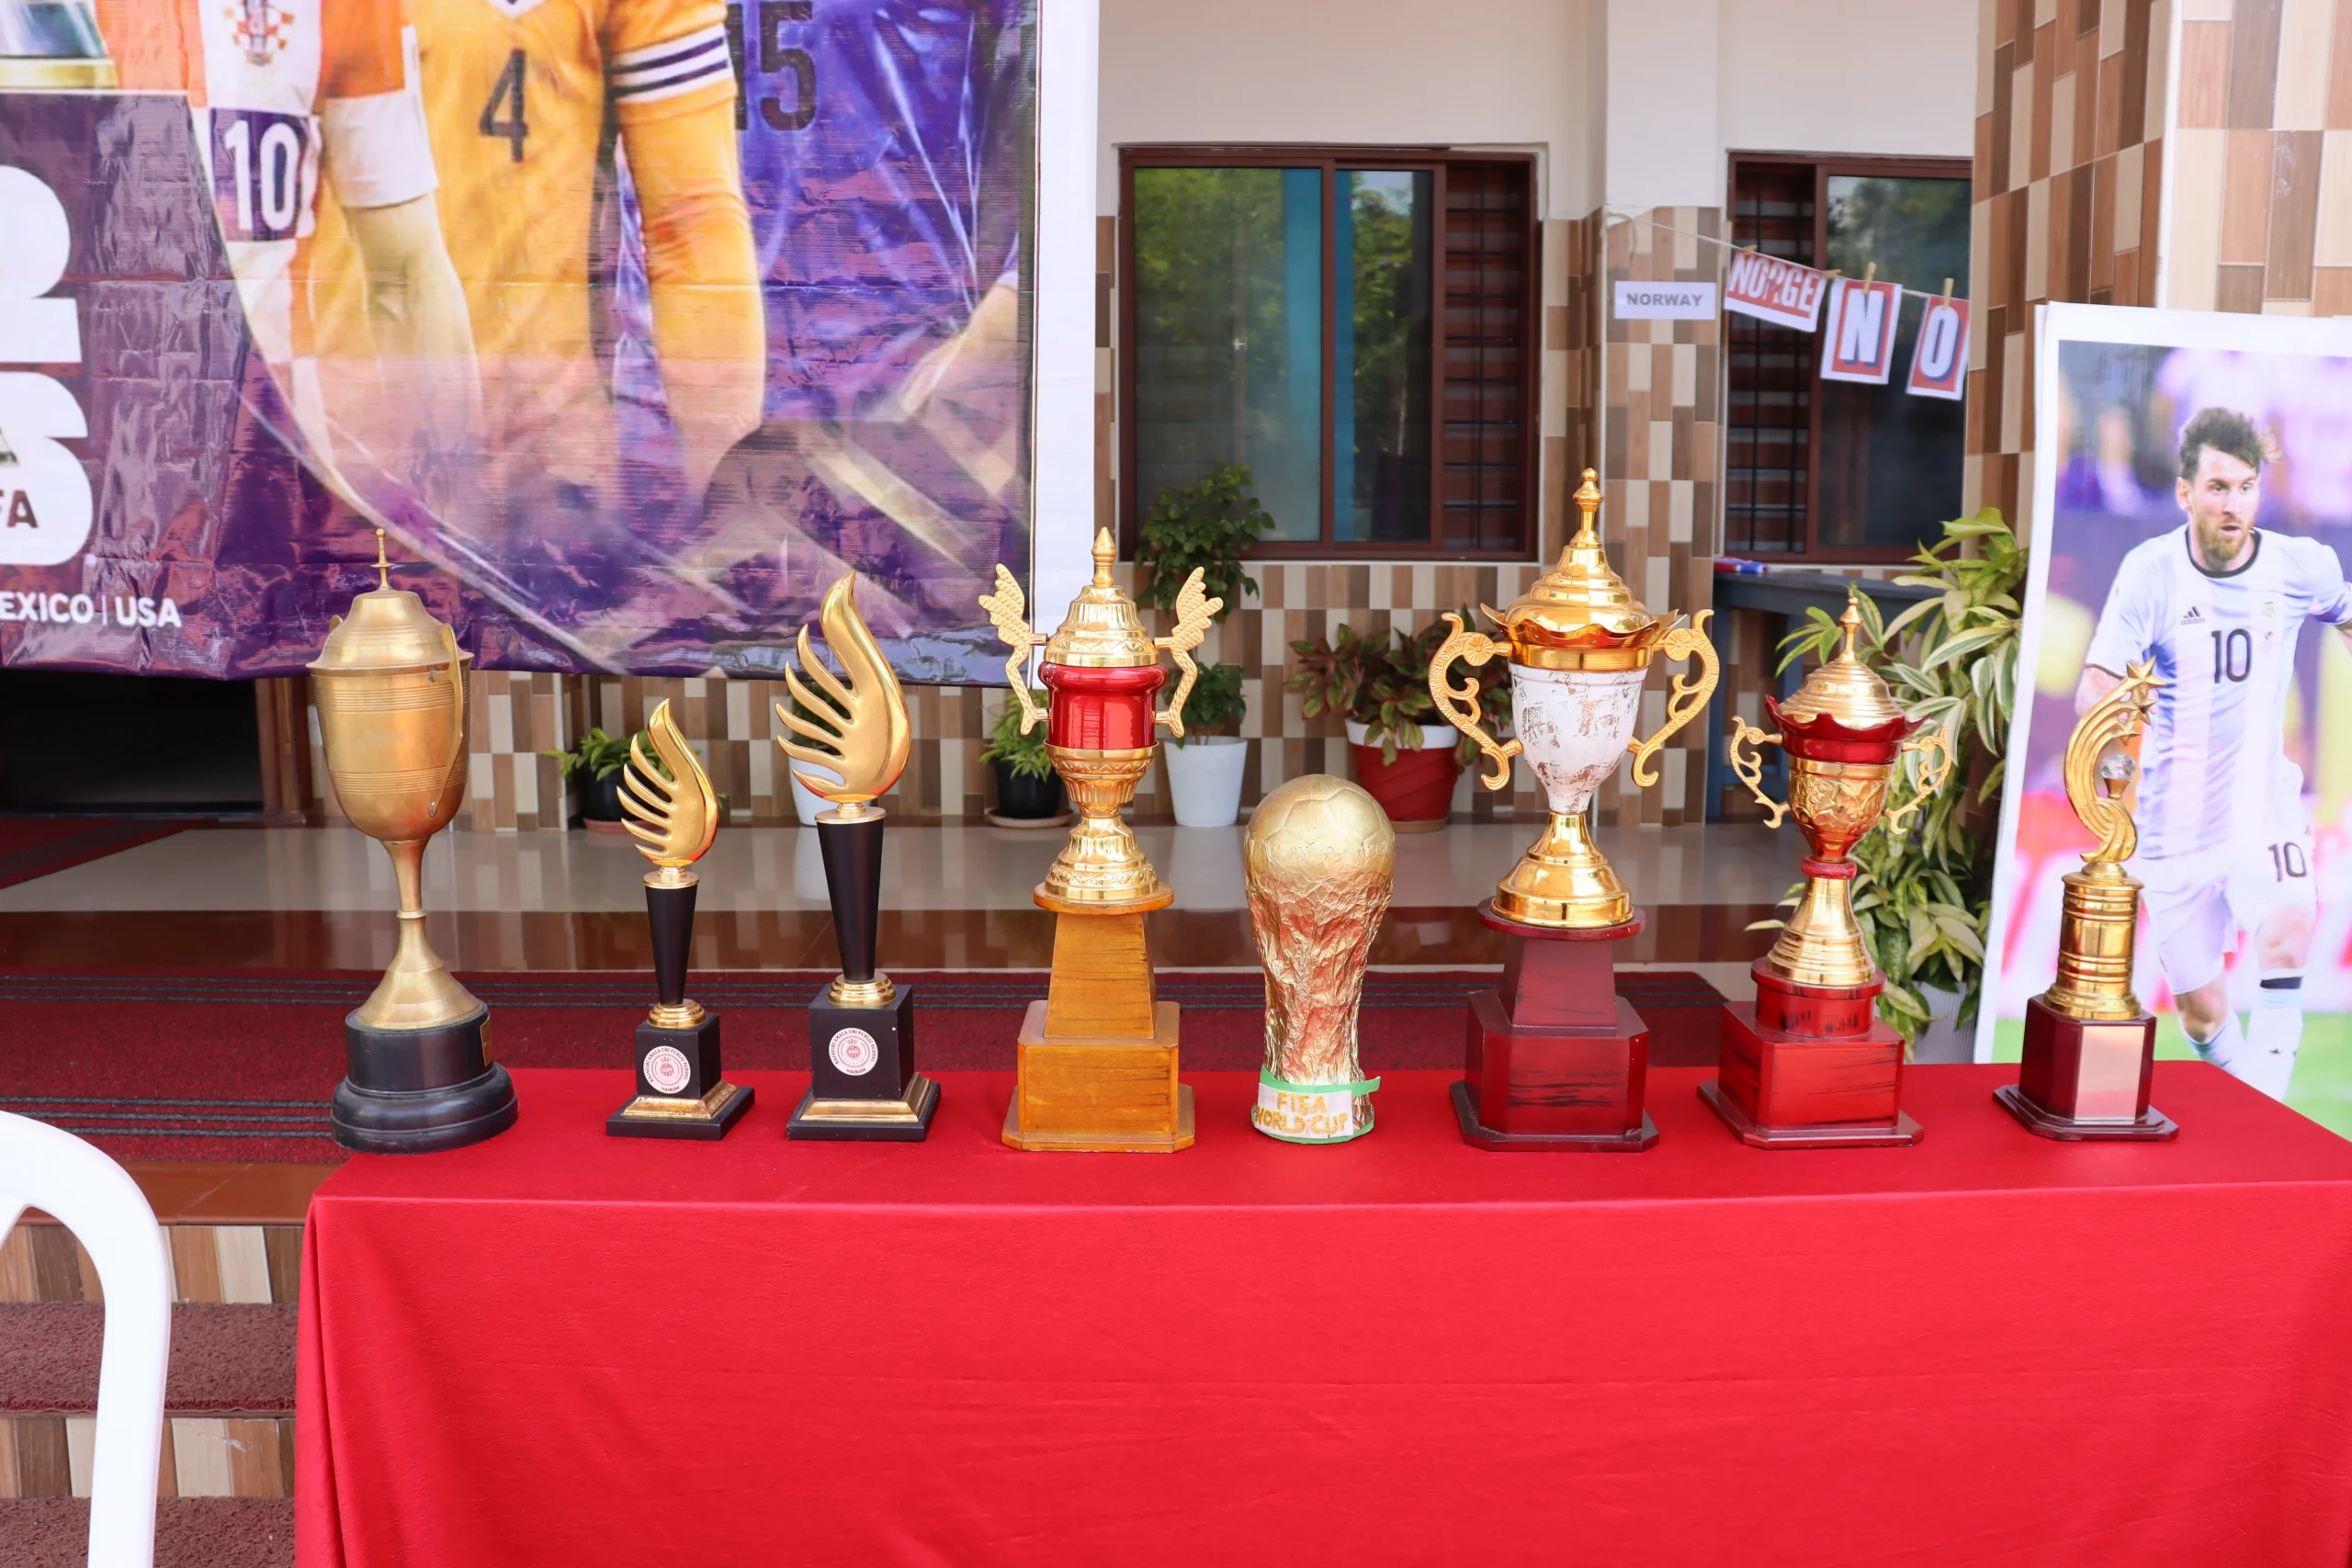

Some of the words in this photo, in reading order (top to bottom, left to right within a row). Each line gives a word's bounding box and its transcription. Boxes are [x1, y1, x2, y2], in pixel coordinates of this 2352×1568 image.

[480, 49, 527, 163] 4
[224, 119, 300, 231] 10
[1626, 292, 1703, 306] NORWAY
[1728, 253, 1820, 313] NORGE
[1839, 288, 1887, 367] N
[1920, 305, 1962, 382] O
[115, 595, 182, 628] USA
[2211, 628, 2252, 684] 10
[2268, 841, 2307, 882] 10
[670, 1048, 685, 1062] PUBLIC
[857, 1030, 874, 1044] PUBLIC
[1255, 1105, 1307, 1134] WORLD
[1310, 1111, 1349, 1135] CUP
[1275, 1090, 1329, 1116] FIFA
